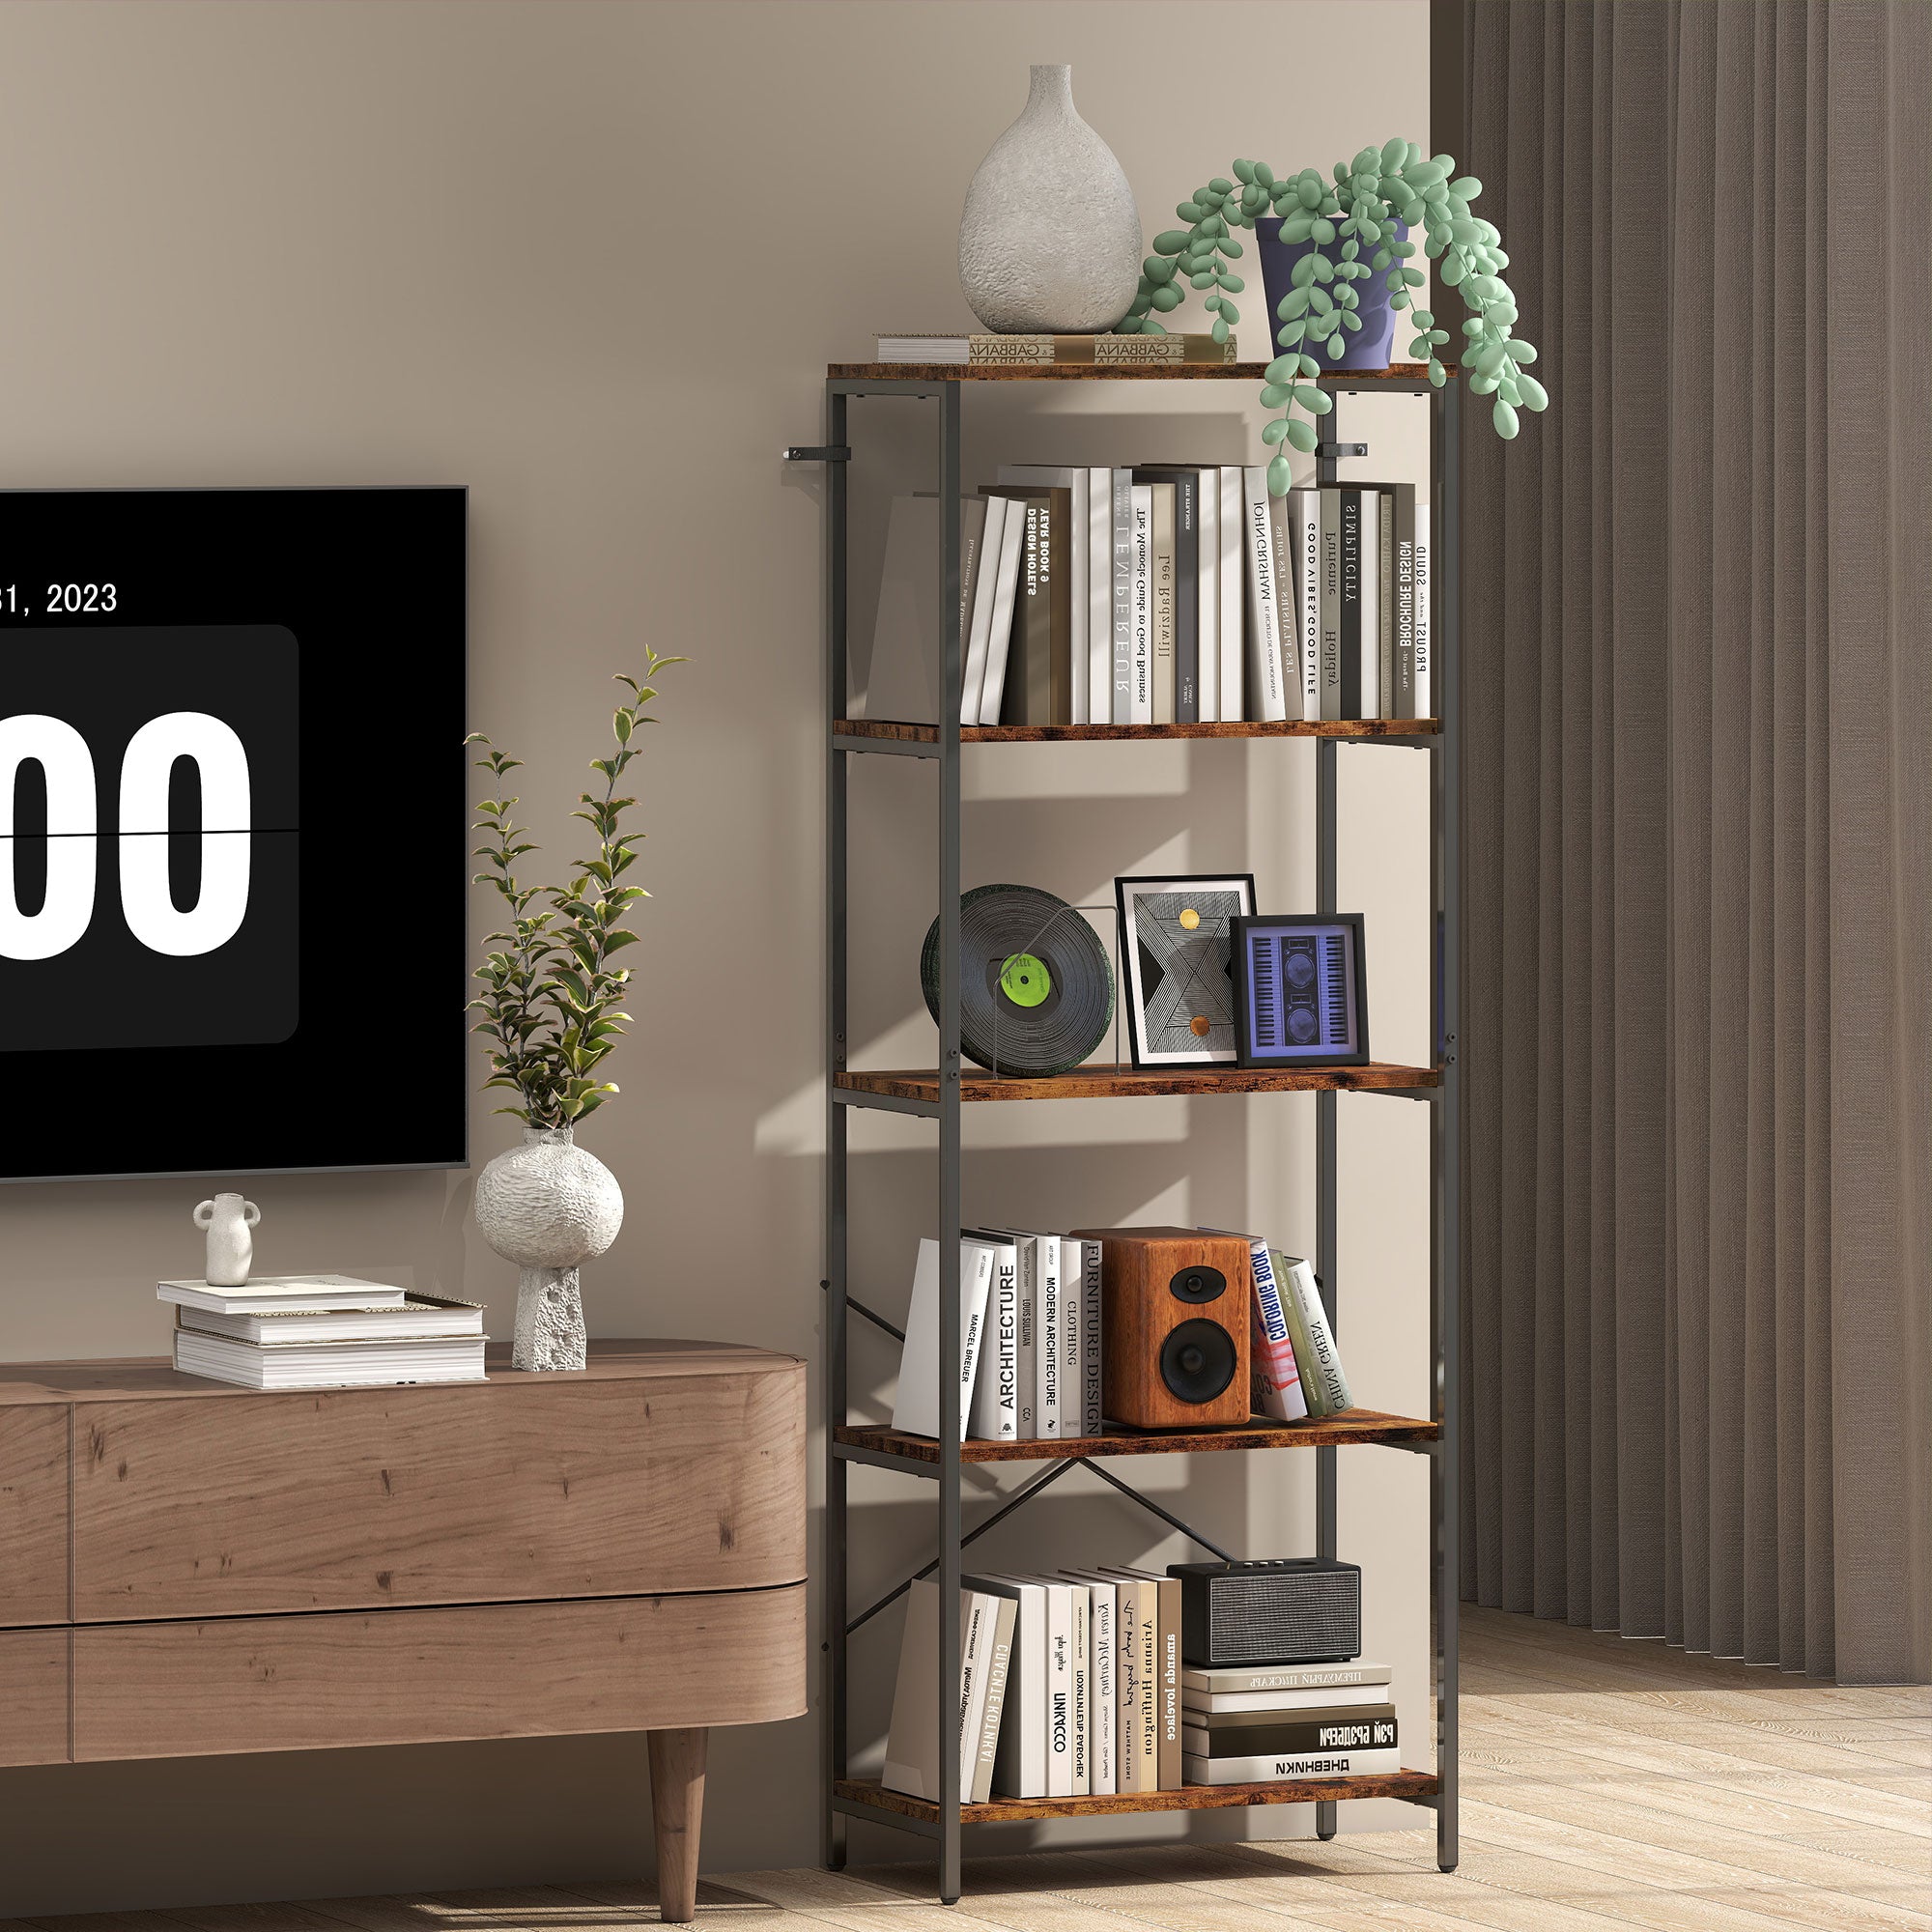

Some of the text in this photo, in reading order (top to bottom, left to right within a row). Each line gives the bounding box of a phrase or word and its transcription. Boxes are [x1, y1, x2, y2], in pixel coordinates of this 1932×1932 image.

[0, 583, 117, 617] 1, 2023
[0, 711, 252, 960] 00
[1022, 1298, 1031, 1318] LOUIS
[1022, 1318, 1031, 1347] SULLIVAN
[1046, 1277, 1056, 1322] MODERN
[1067, 1300, 1077, 1366] CLOTHING
[962, 1314, 978, 1383] MARCEL BREUER
[999, 1265, 1014, 1410] ARCHITECTURE
[1046, 1325, 1056, 1406] ARCHITECTURE
[1087, 1244, 1099, 1435] FURNITURE DESIGN
